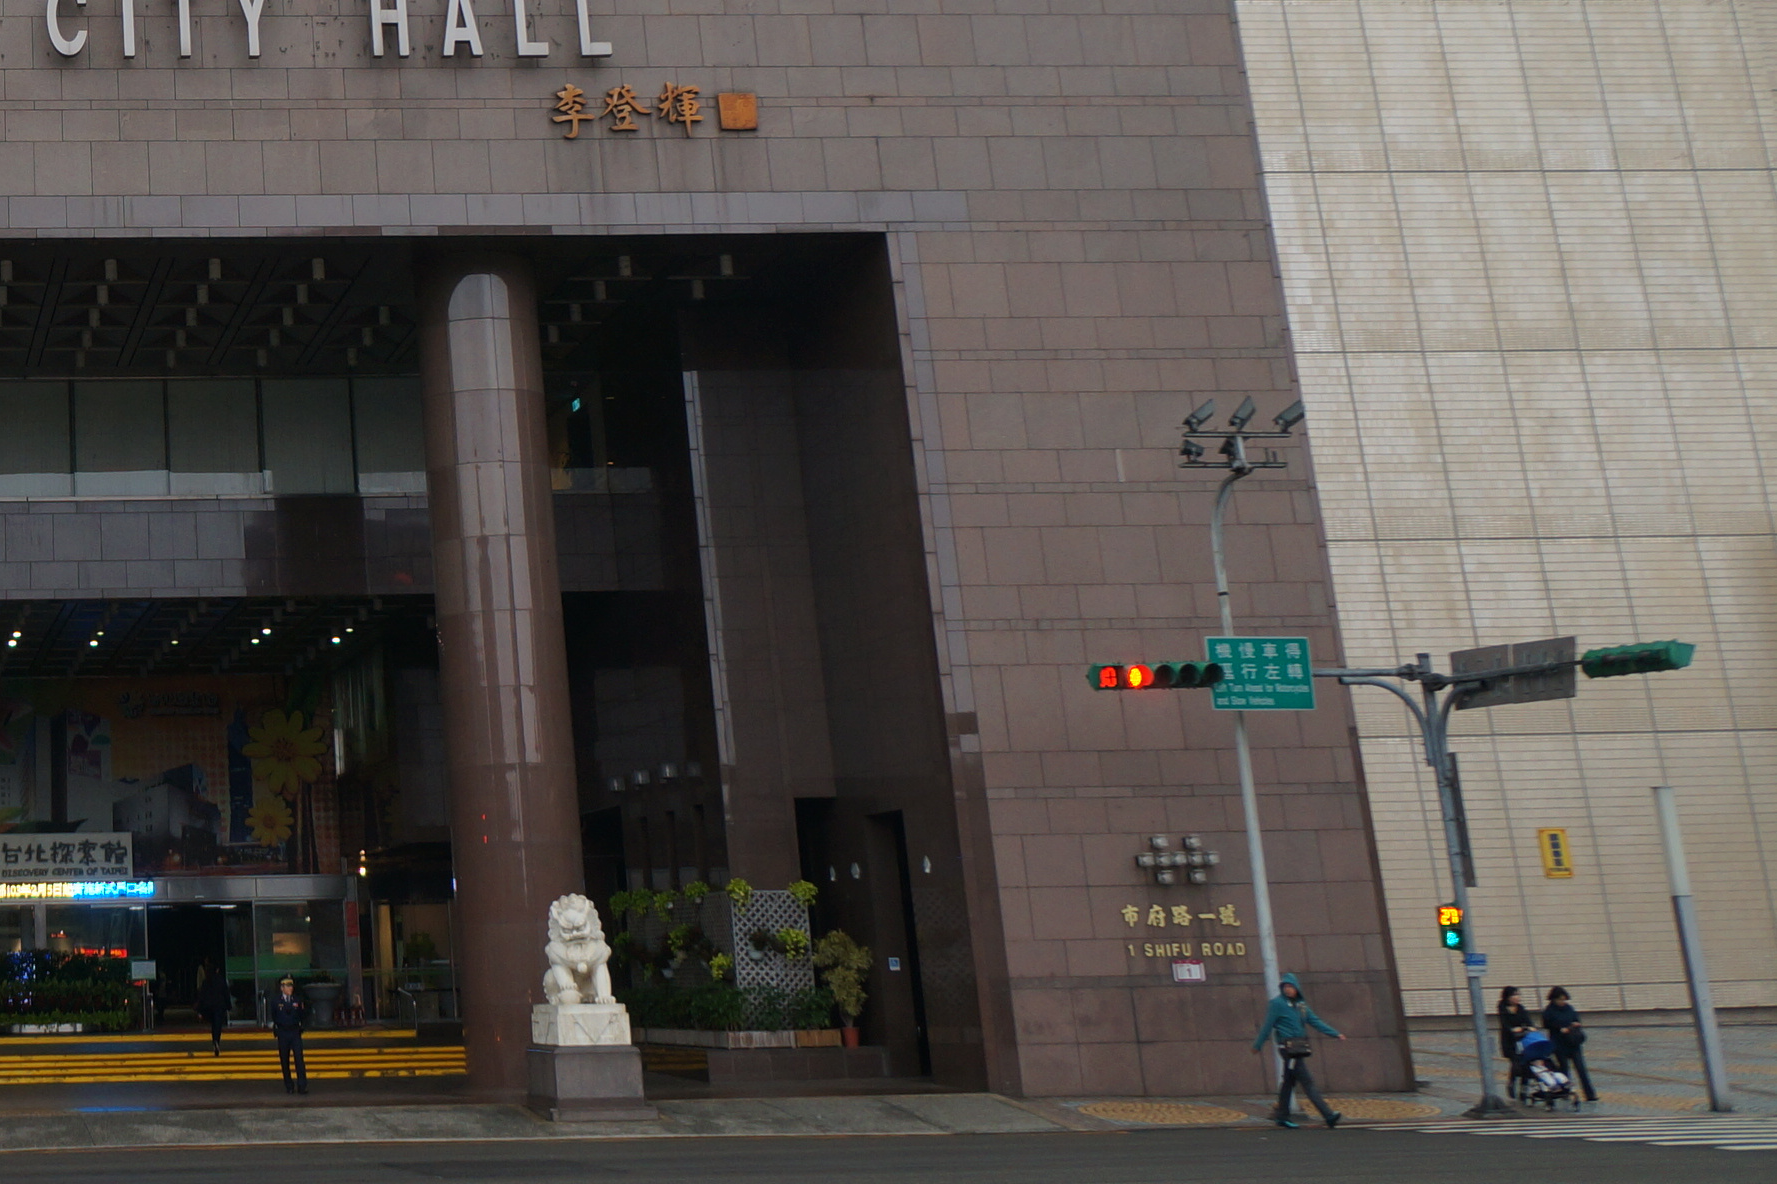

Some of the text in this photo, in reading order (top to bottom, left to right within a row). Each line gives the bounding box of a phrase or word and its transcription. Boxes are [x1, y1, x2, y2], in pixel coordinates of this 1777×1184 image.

[551, 81, 704, 139] 李登輝
[1, 838, 128, 866] 台北探索館
[1, 866, 129, 878] DISCOVERY CENTER OF TAIPEI
[1121, 904, 1241, 927] 市府路一號
[1127, 942, 1246, 957] 1 SHIFU ROAD
